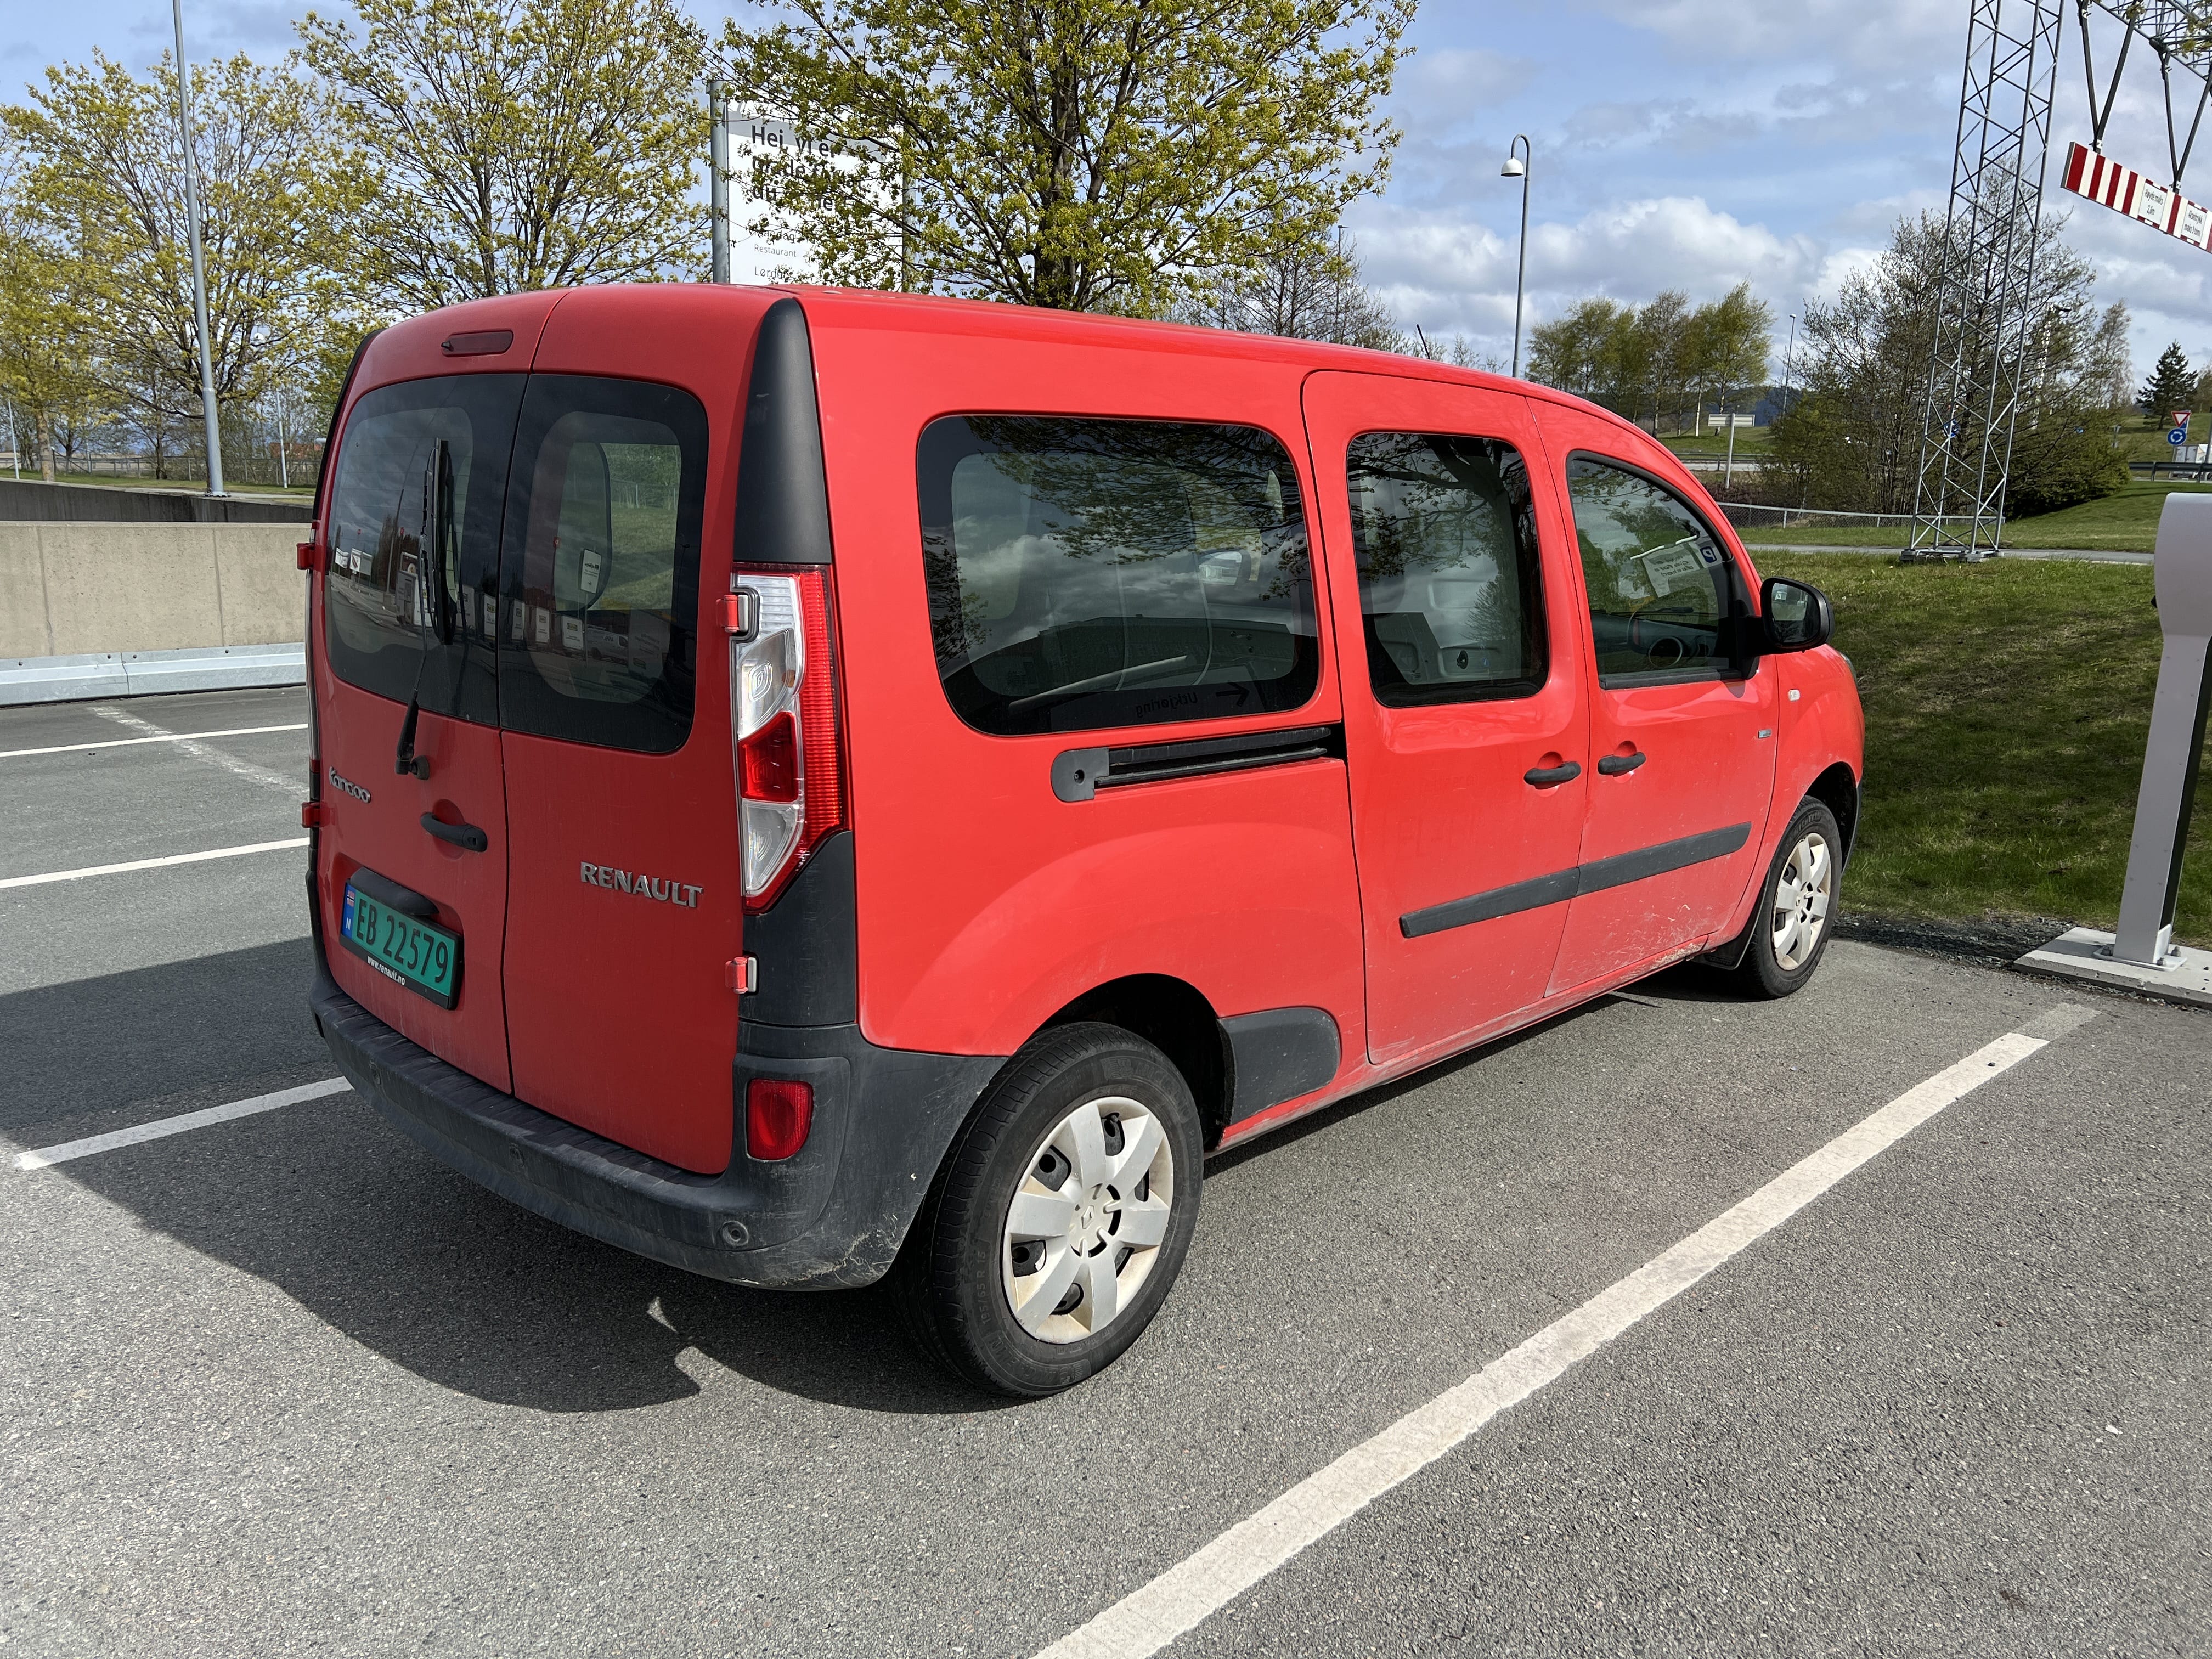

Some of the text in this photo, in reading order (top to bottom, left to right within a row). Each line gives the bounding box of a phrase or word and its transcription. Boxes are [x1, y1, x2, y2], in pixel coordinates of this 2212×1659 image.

[754, 244, 797, 258] Restaurant
[580, 861, 703, 908] RENAULT
[346, 917, 351, 930] N
[356, 898, 448, 983] EB 22579
[367, 956, 405, 986] www.renault.no
[976, 1250, 991, 1328] 195/65 R 15
